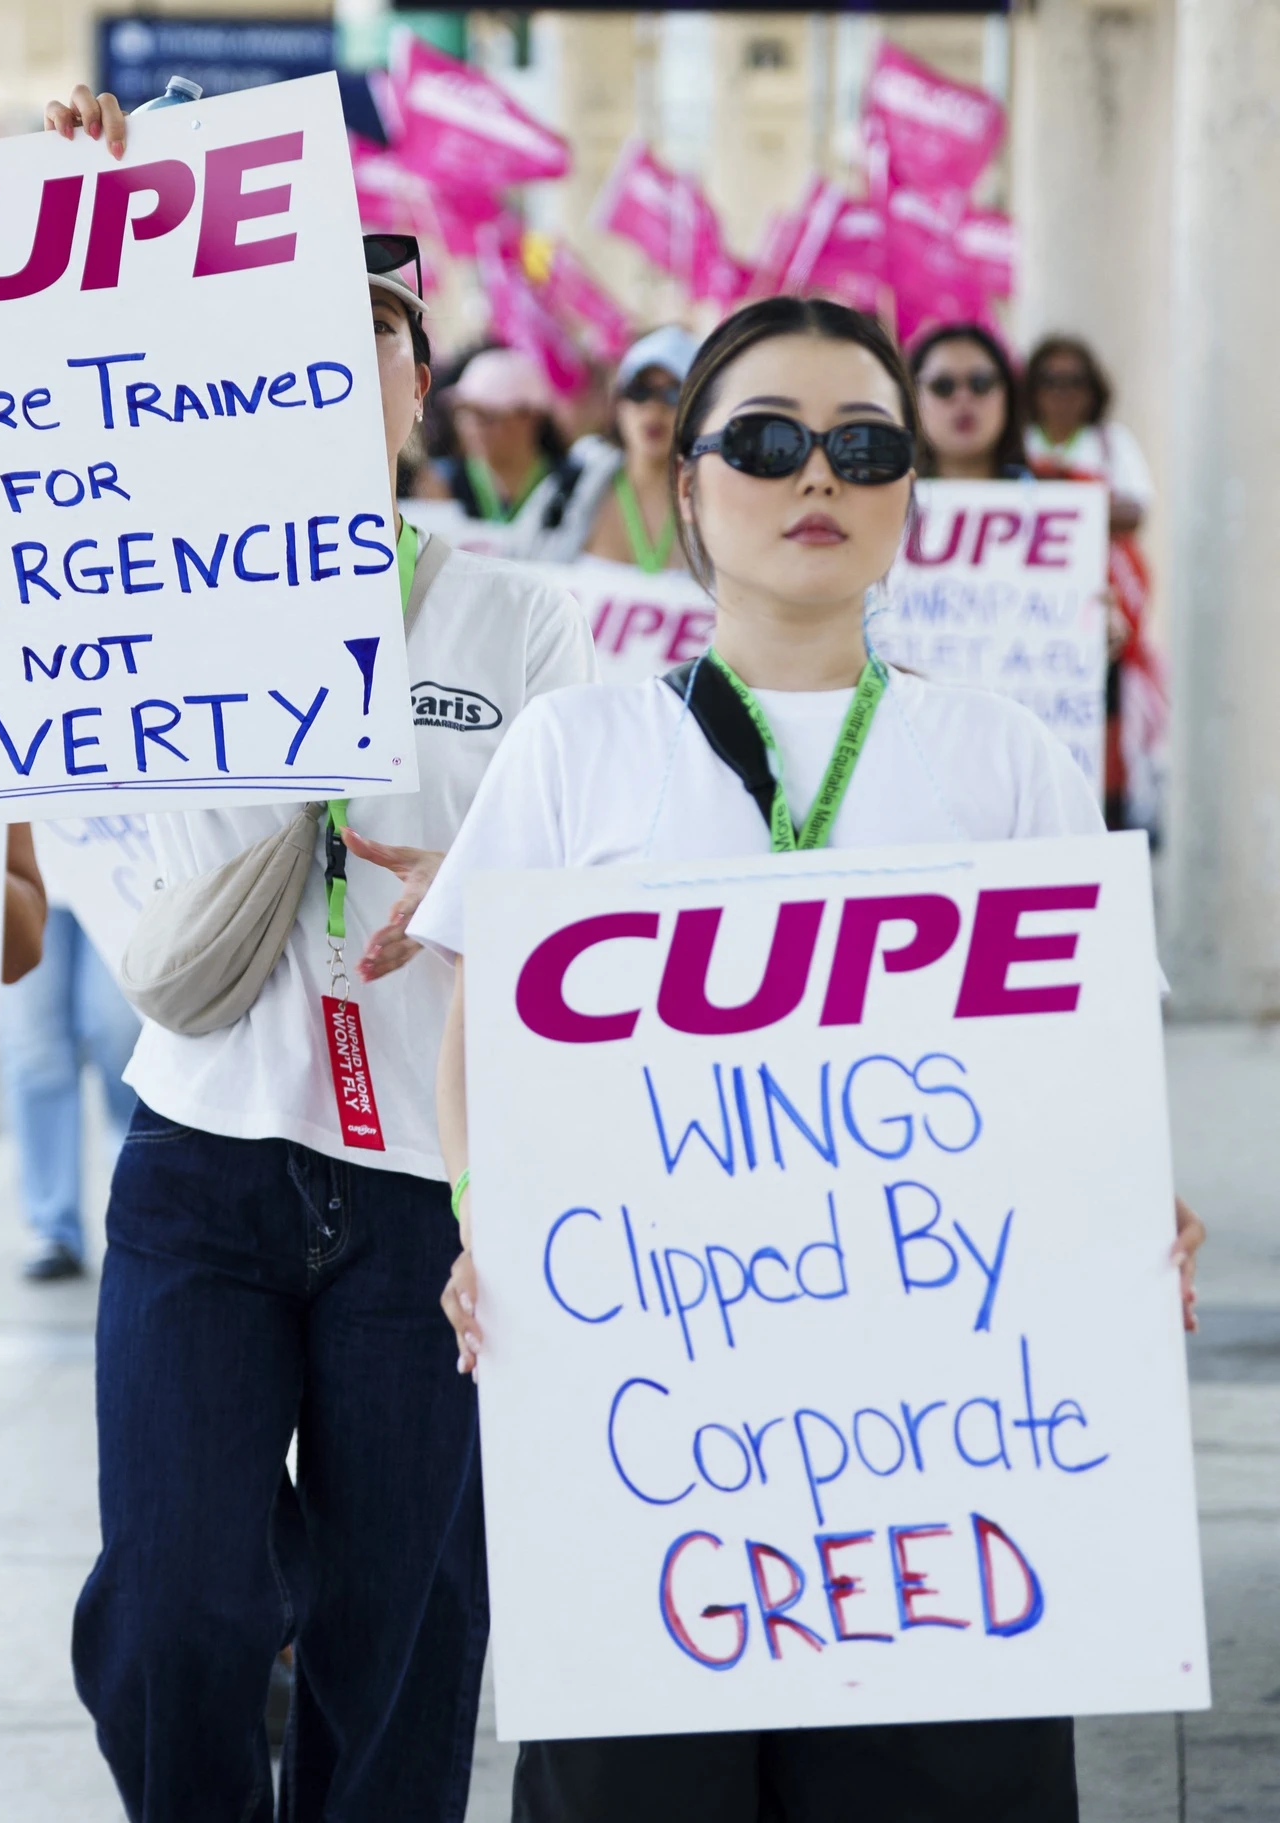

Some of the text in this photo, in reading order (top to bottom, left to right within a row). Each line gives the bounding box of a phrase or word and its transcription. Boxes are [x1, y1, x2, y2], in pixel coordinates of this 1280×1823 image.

[0, 461, 131, 513] FOR
[904, 509, 1079, 567] UPE
[22, 634, 153, 682] NOT
[844, 700, 874, 744] Contrat
[820, 745, 859, 805] Équitable
[802, 808, 831, 849] Mainte
[515, 883, 1101, 1043] CUPE
[332, 1013, 360, 1111] WON'T FLY
[346, 1015, 362, 1067] UNPAID
[354, 1071, 371, 1114] WORK
[643, 1053, 982, 1177] WINGS
[543, 1180, 1013, 1361] Clipped By
[608, 1336, 1110, 1524] Corporate
[658, 1512, 1045, 1672] GREED
